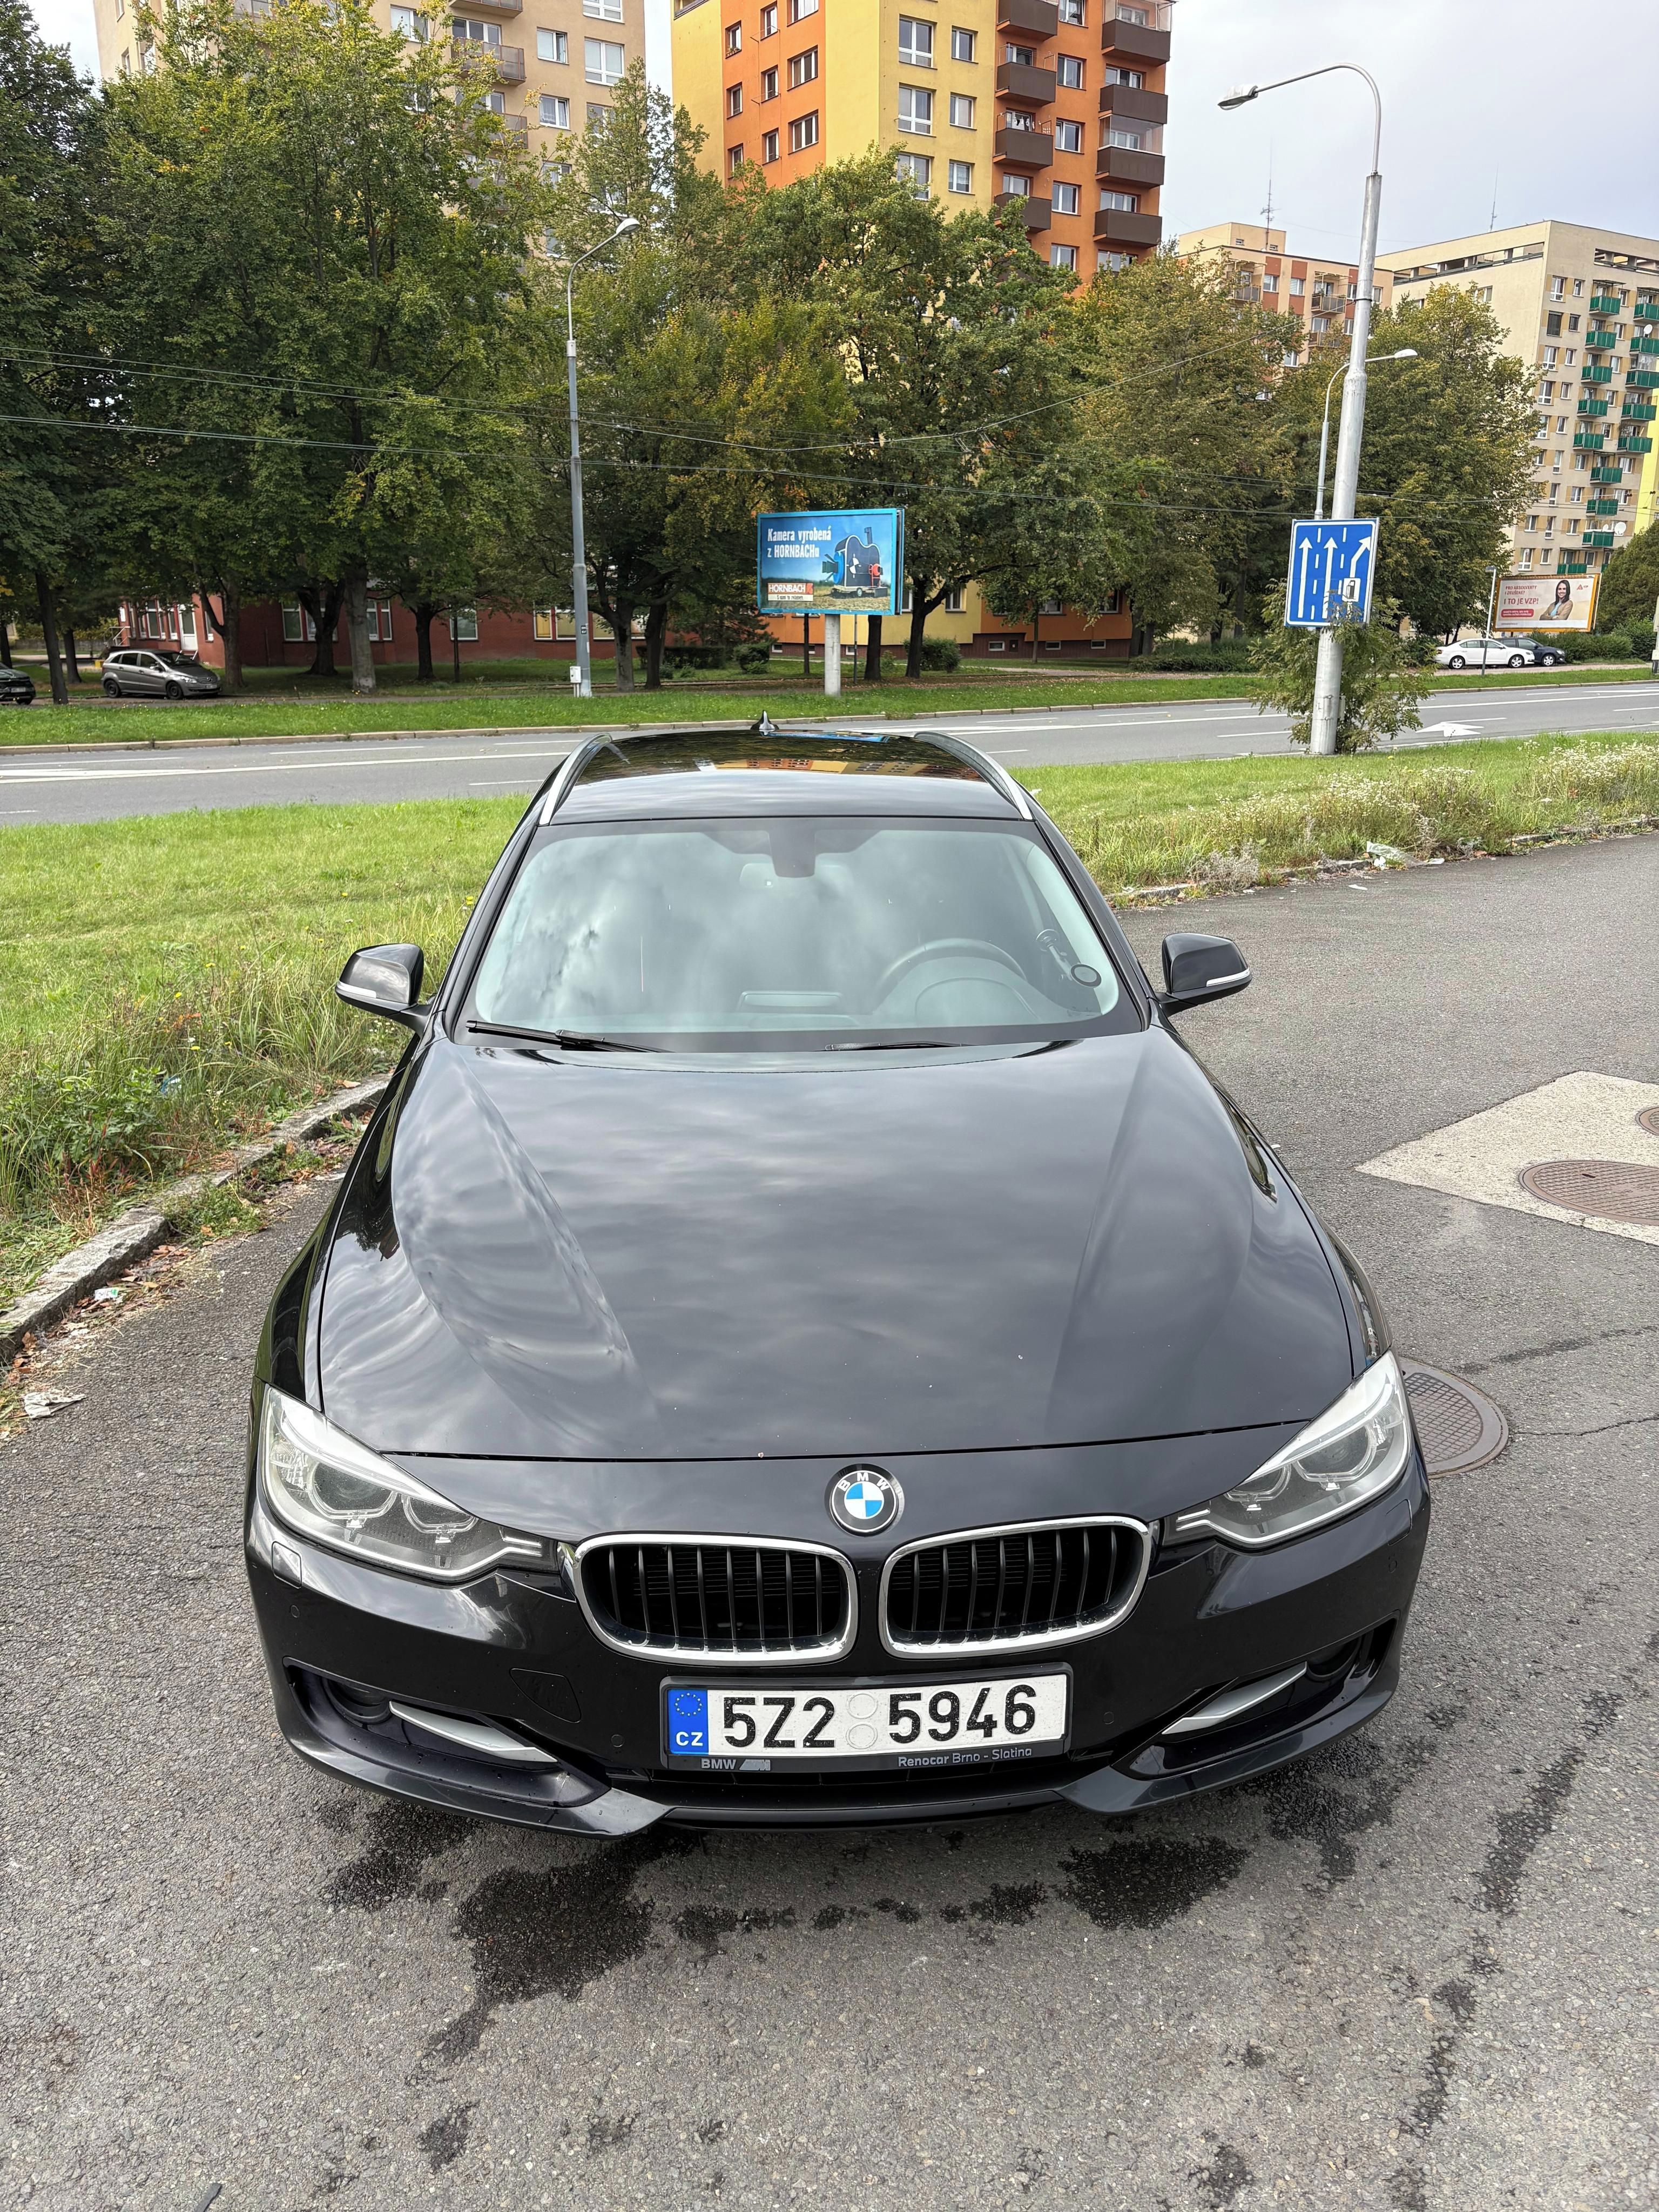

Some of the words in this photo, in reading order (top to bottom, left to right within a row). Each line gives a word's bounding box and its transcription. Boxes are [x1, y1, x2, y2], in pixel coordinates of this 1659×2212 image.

[767, 529, 795, 542] Kamera
[798, 525, 832, 544] vyrobená
[767, 548, 772, 558] z
[774, 544, 820, 558] HORNBACHu
[768, 584, 806, 593] HORNBACH
[838, 1472, 890, 1492] BMW
[724, 1697, 835, 1748] 5Z2
[889, 1684, 1036, 1744] 5946
[676, 1731, 703, 1746] CZ
[701, 1758, 736, 1770] BMW
[898, 1756, 949, 1767] Renocar
[952, 1752, 980, 1763] Brno
[992, 1748, 1032, 1760] Slatina
